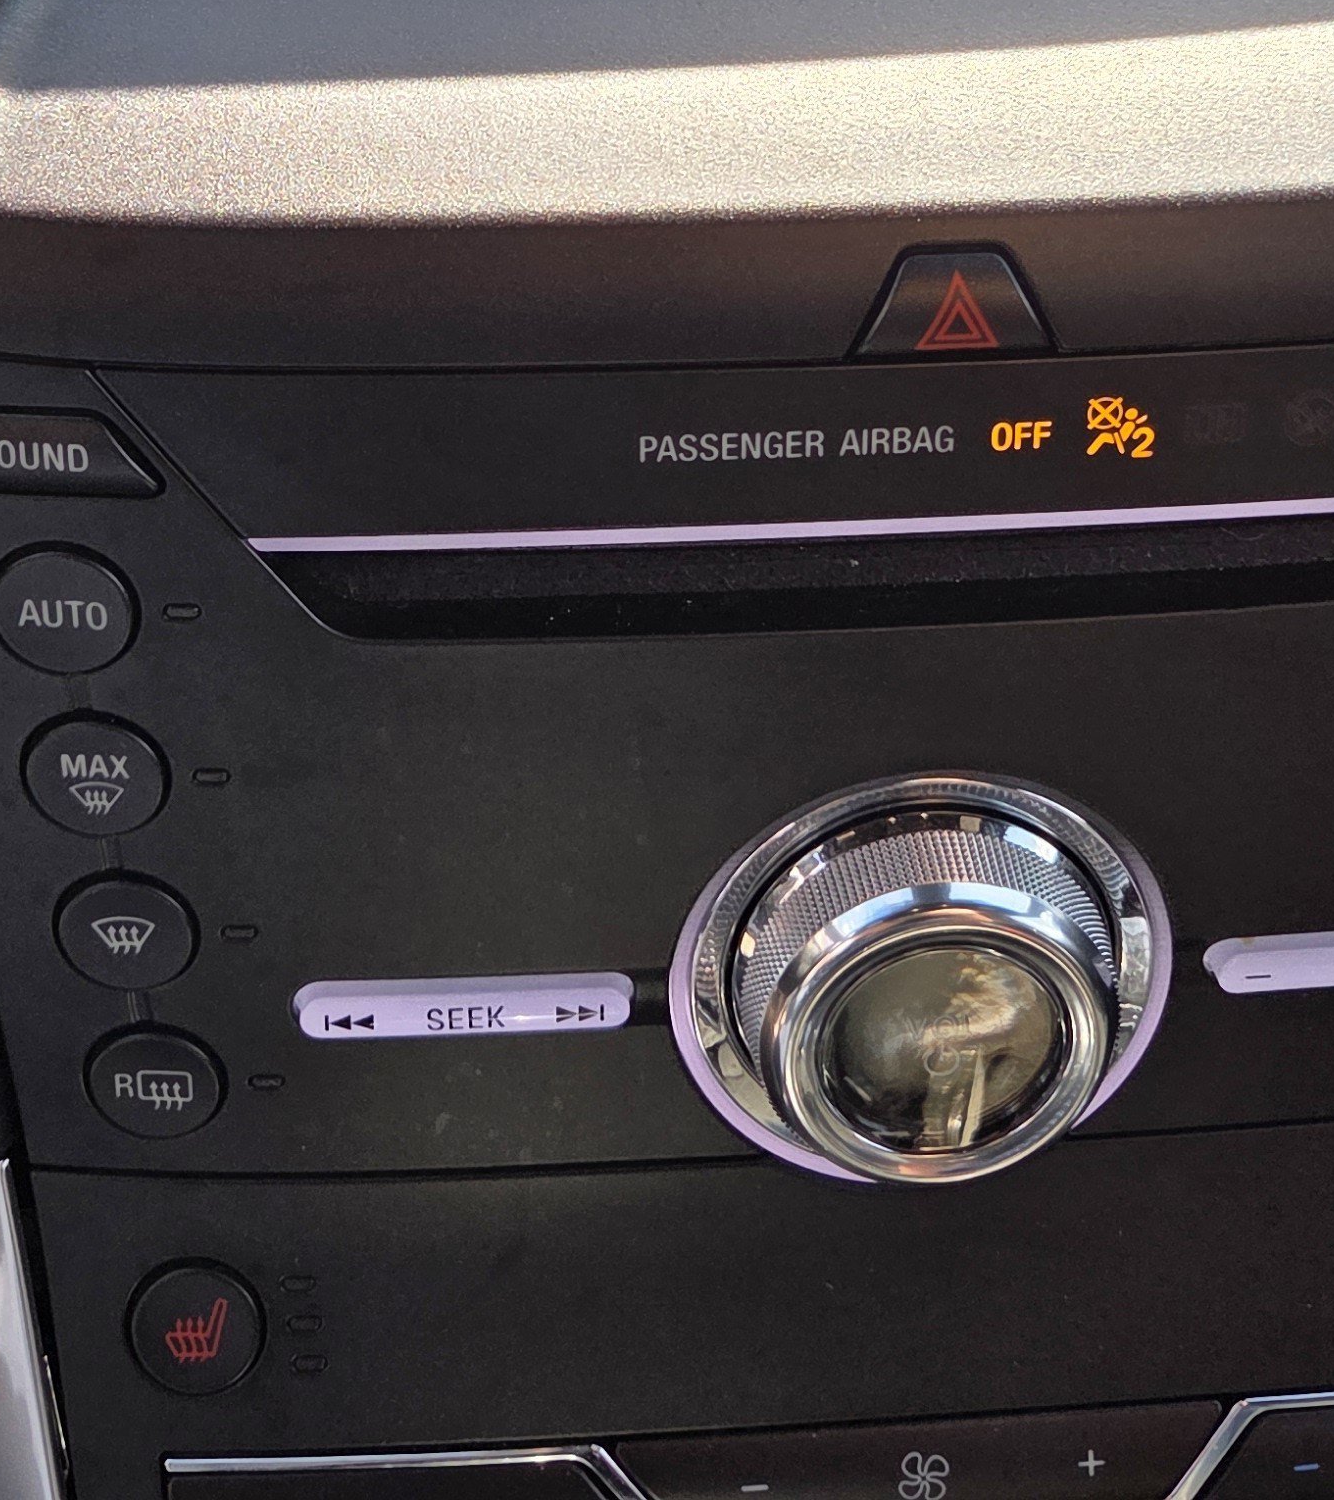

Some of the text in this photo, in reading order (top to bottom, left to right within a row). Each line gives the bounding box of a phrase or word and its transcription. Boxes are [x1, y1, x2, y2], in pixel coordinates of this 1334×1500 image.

[638, 420, 1053, 464] PASSENGER AIRBAG OFF
[18, 599, 109, 631] AUTO
[60, 753, 131, 780] MAX
[425, 1005, 506, 1031] SEEK
[114, 1072, 134, 1099] R
